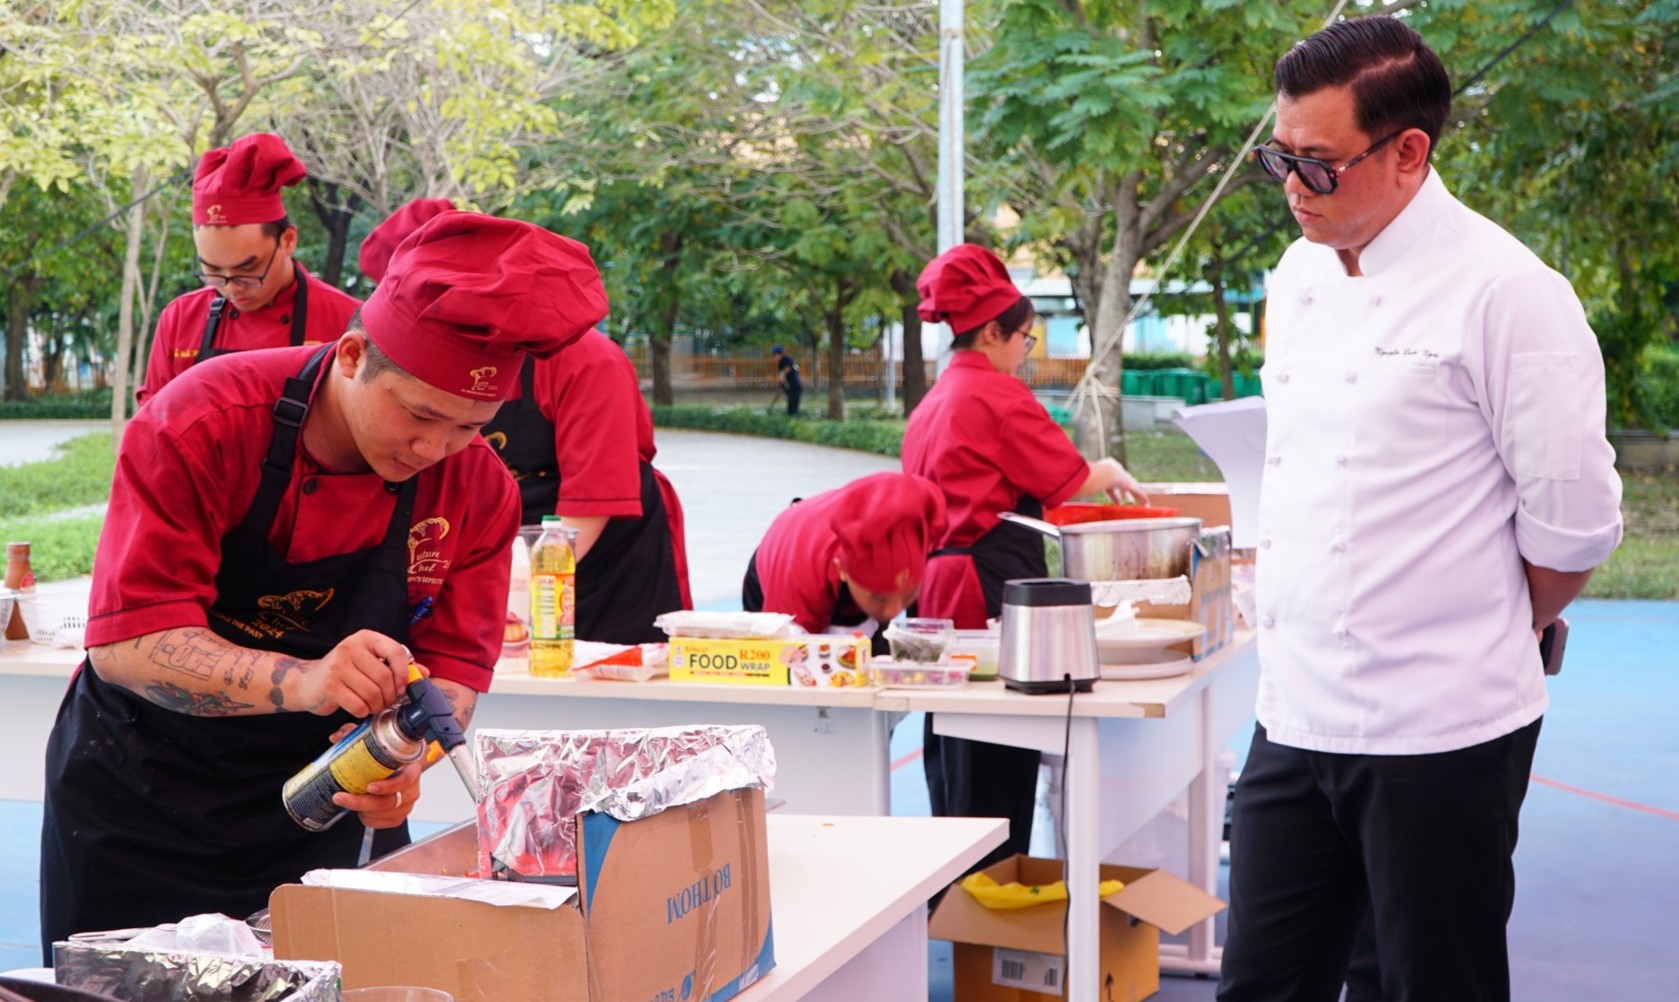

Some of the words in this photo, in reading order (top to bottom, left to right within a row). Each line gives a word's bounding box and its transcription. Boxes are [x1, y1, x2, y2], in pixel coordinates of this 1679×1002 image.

[243, 625, 264, 640] PAST
[689, 653, 738, 670] FOOD
[740, 662, 771, 671] WRAP
